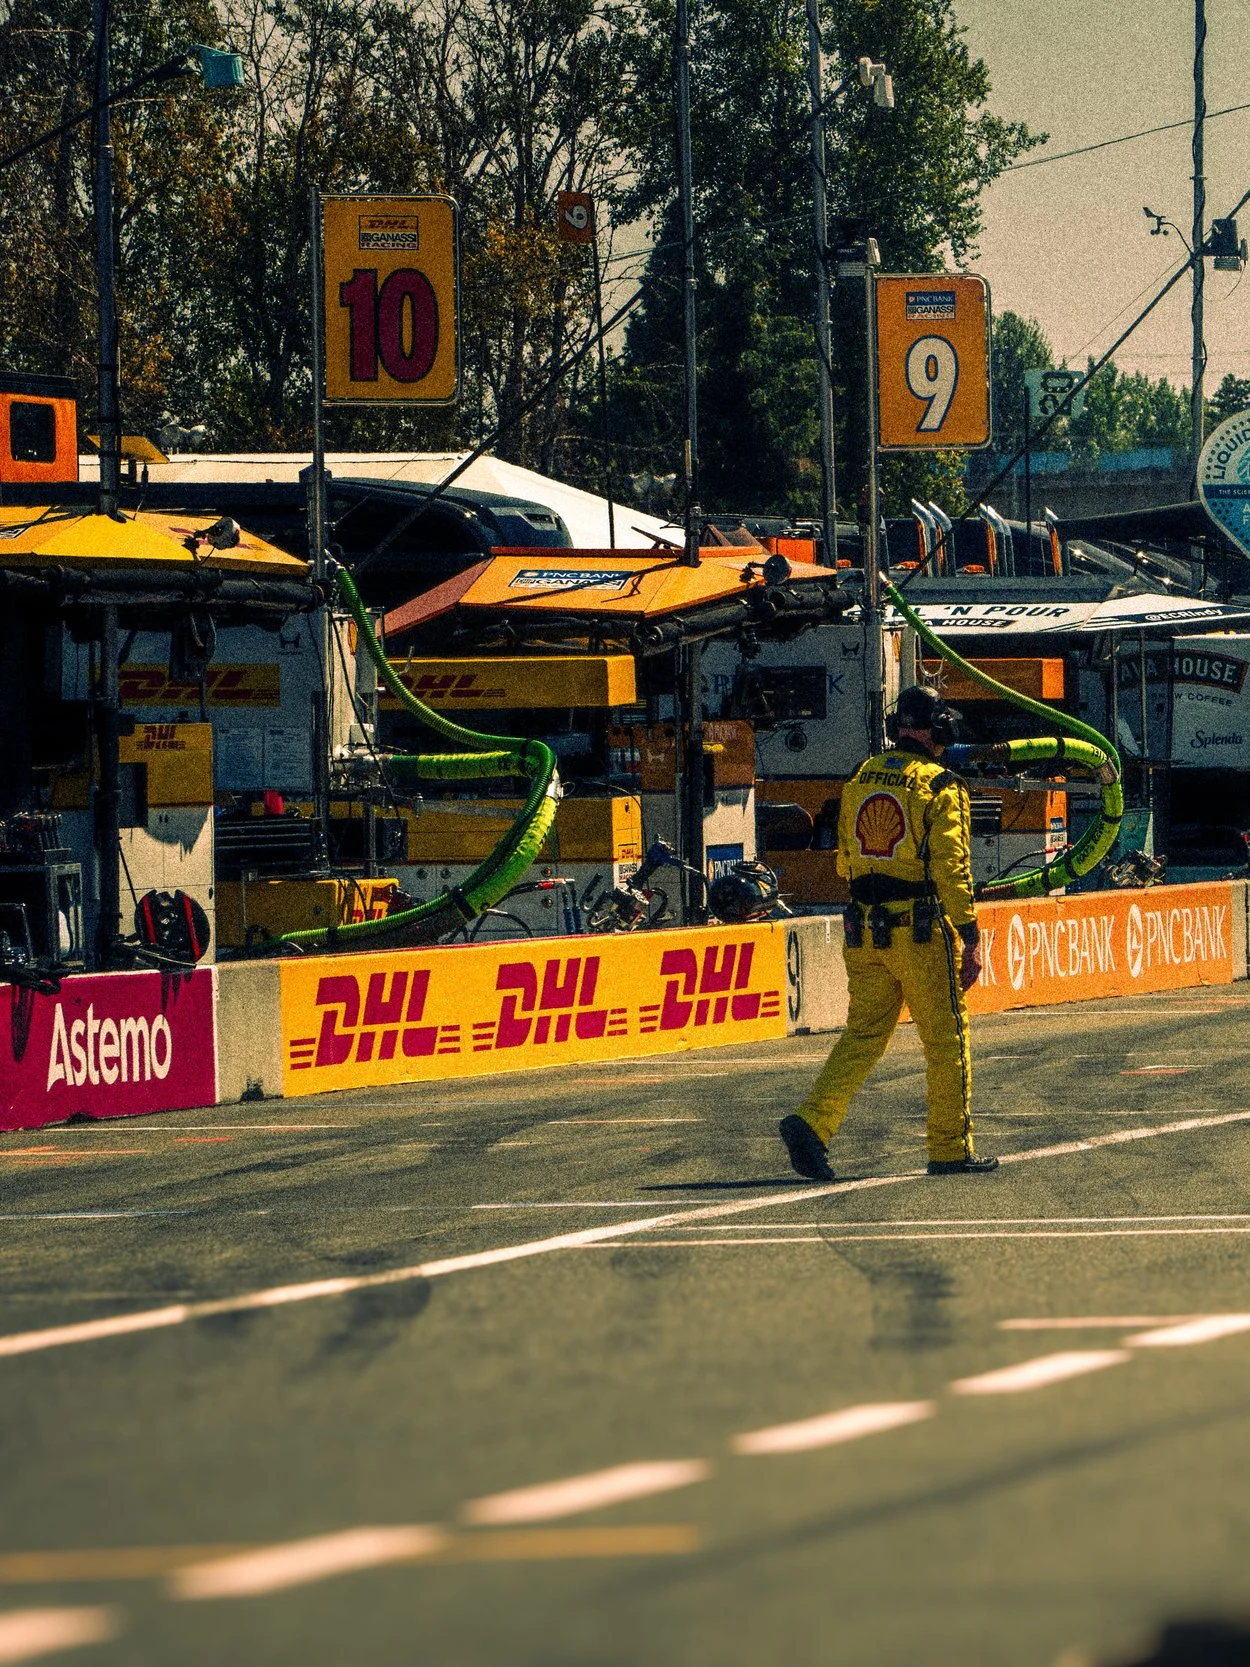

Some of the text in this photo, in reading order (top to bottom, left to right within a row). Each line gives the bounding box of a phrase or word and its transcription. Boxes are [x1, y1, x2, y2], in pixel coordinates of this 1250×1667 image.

[371, 232, 417, 242] GANASSI
[917, 305, 955, 313] GANASSI
[339, 267, 440, 384] 10
[905, 334, 960, 433] 9
[983, 605, 1070, 618] POUR
[1145, 608, 1224, 622] @ECRIndy
[943, 618, 1005, 627] HOUSE
[1187, 692, 1234, 707] COFFEE
[1190, 730, 1244, 749] Splenda
[858, 770, 916, 791] OFFICIAL
[659, 942, 762, 1032] DHL
[495, 956, 608, 1050] DHL
[314, 969, 439, 1068] DHL
[46, 1002, 172, 1092] Astemo
